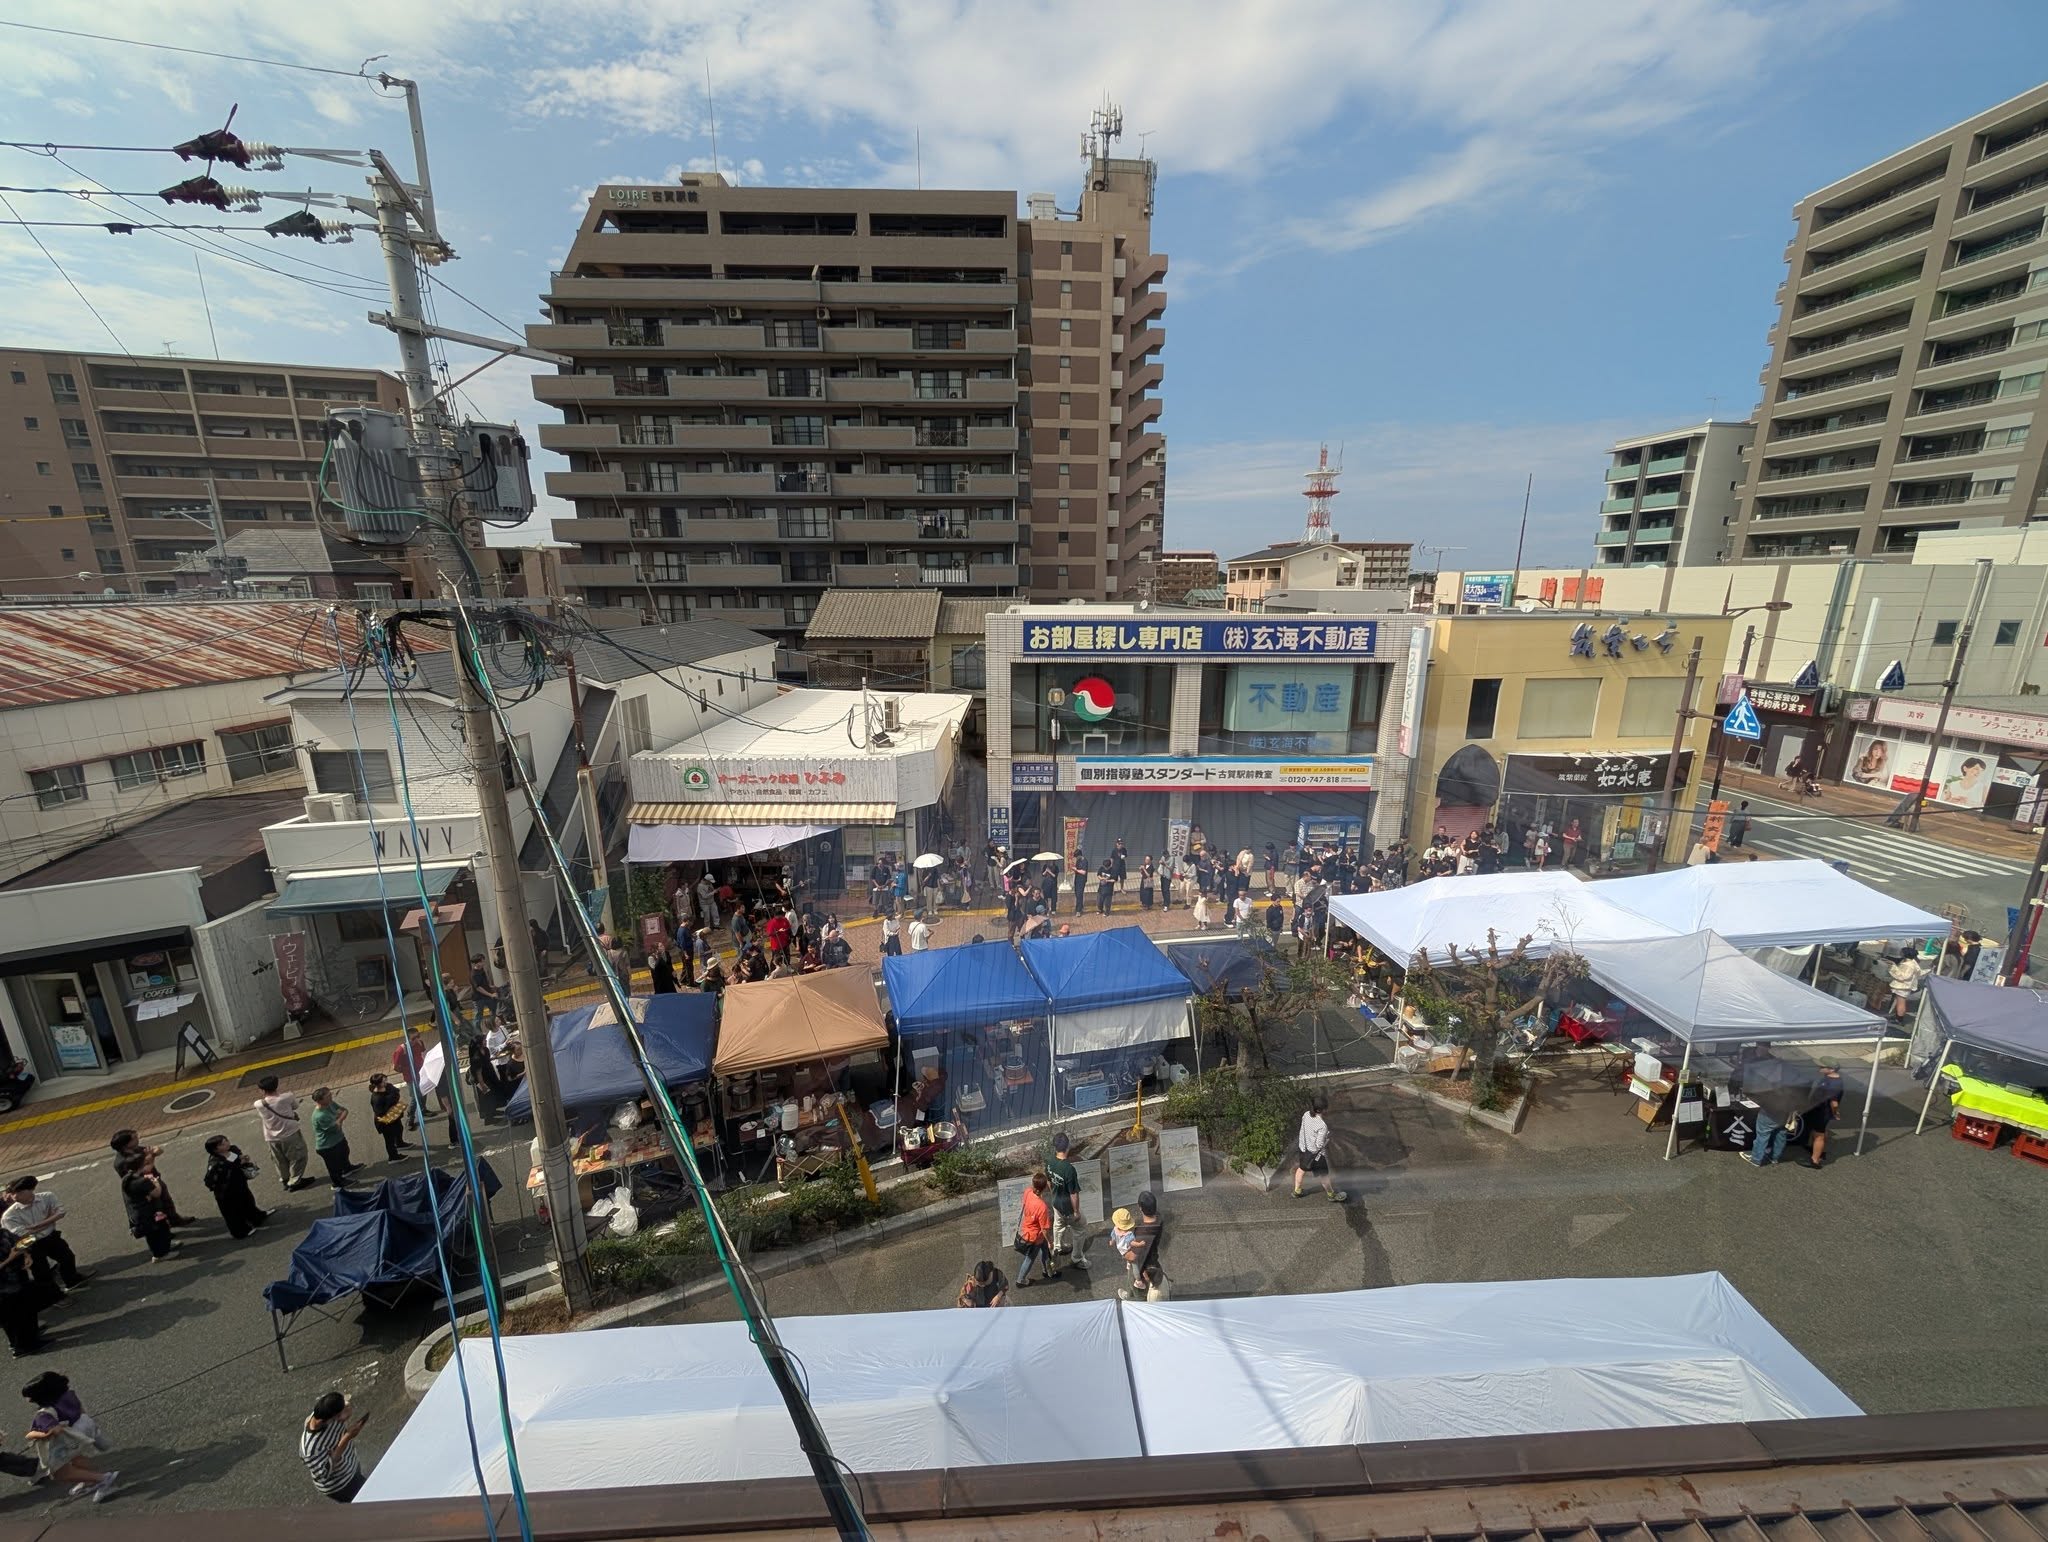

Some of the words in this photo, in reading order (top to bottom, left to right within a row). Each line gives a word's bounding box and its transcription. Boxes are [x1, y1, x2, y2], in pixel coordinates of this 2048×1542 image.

[608, 189, 648, 200] LOIRE
[1029, 625, 1203, 650] お部屋探し専門店
[1248, 682, 1341, 713] 不動産
[1750, 688, 1800, 703] 各種ご宴会の
[1749, 697, 1807, 713] ご予約承ります
[1907, 710, 1925, 720] 美容
[1981, 720, 2029, 734] プラージュ
[719, 773, 799, 785] オーガニック広場
[803, 771, 846, 785] ひふみ
[1080, 767, 1216, 780] 個別指導塾スタンダード
[1218, 769, 1273, 779] 古賀駅前教室
[1597, 769, 1652, 787] 如水庵
[368, 825, 453, 858] WAVY
[144, 985, 176, 998] COFFEE
